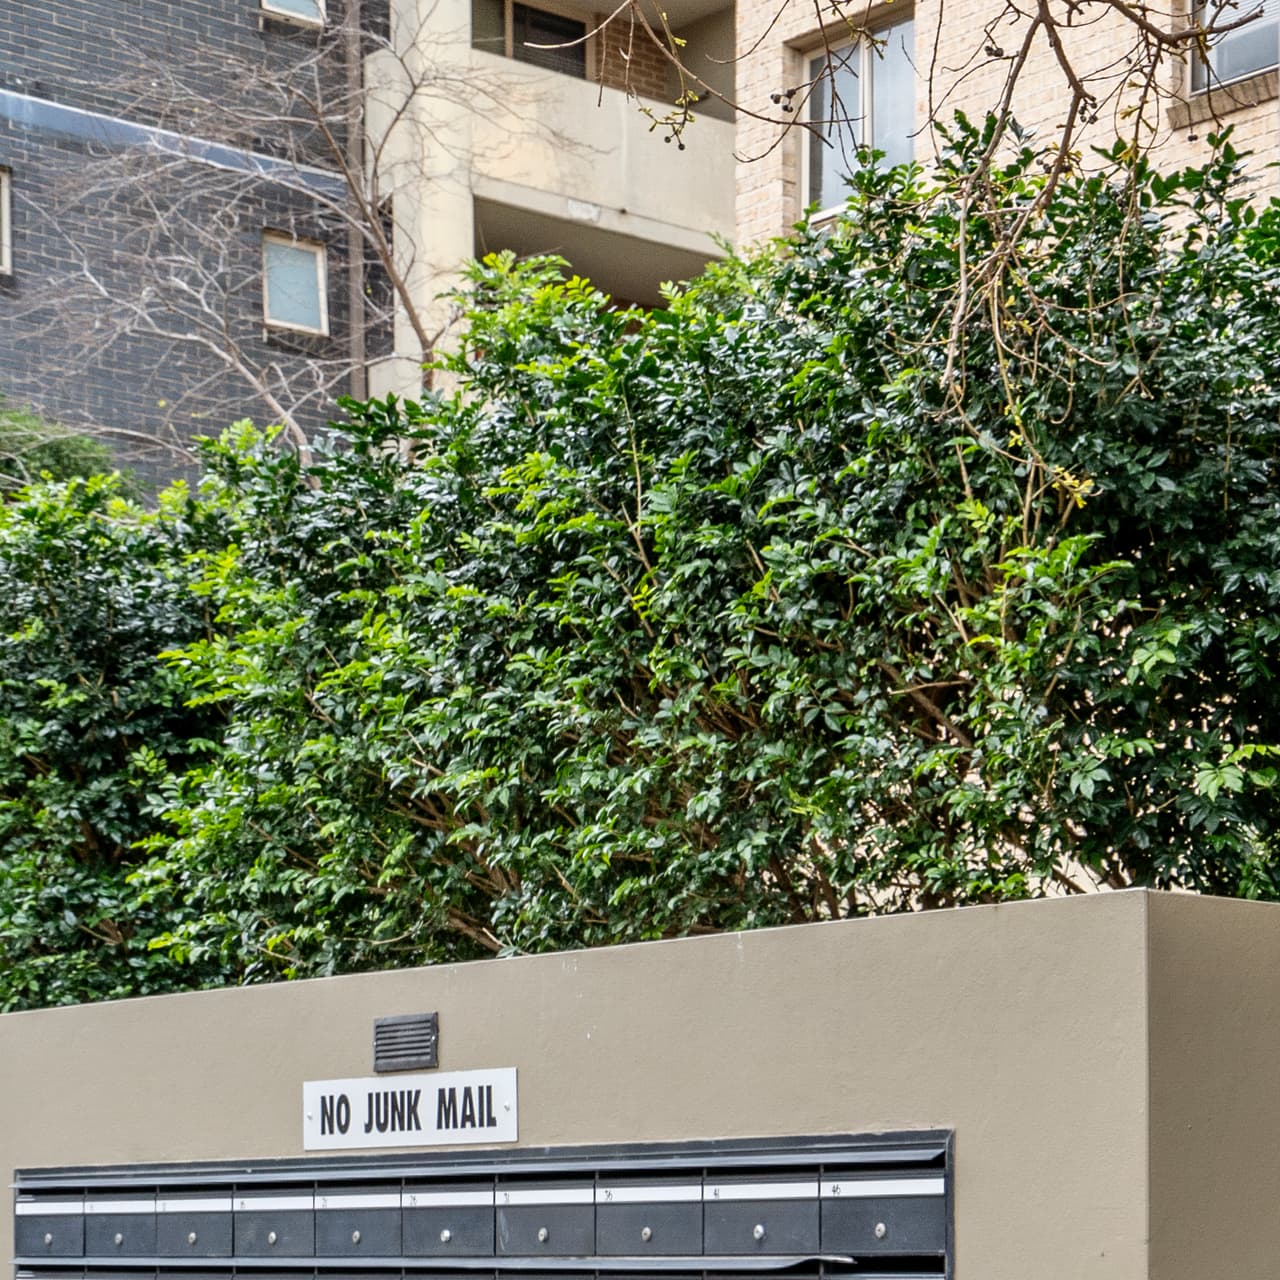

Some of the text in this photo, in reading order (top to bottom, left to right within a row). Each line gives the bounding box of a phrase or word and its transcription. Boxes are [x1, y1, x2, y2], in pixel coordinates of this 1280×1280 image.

[320, 1085, 497, 1135] NO JUNK MAIL
[832, 1184, 841, 1196] 46
